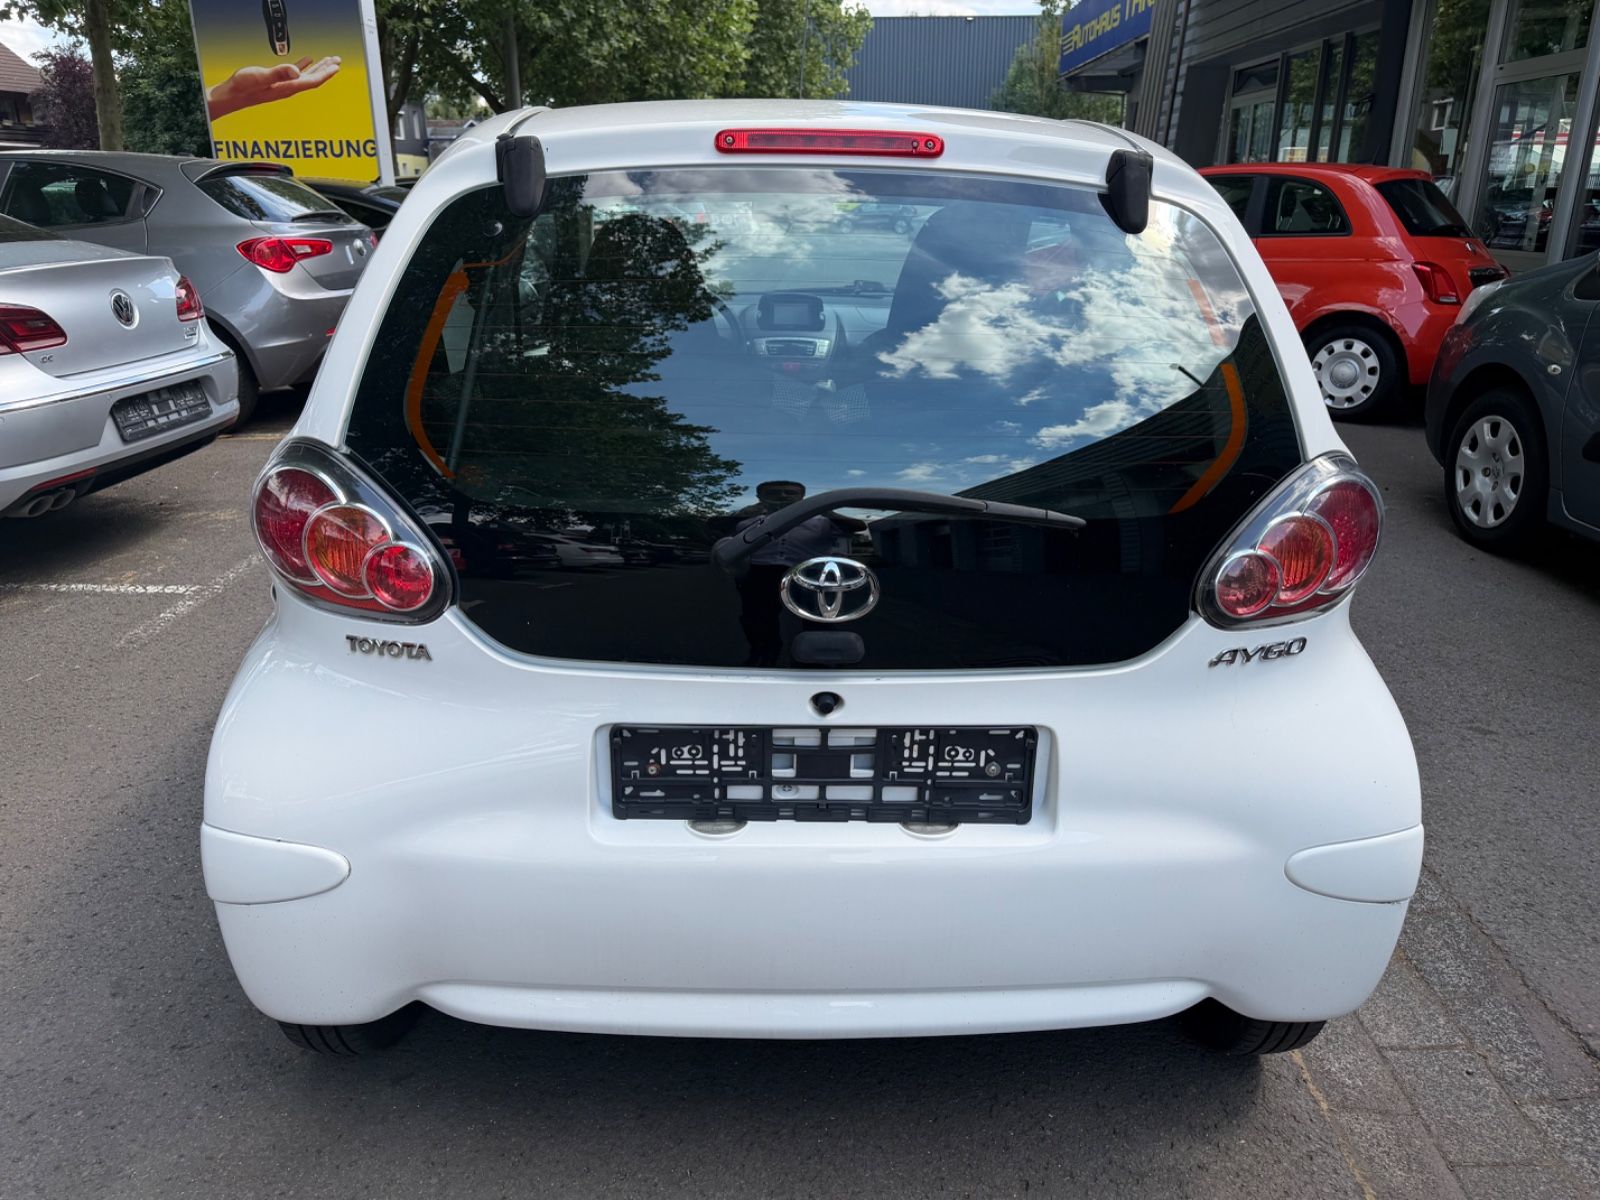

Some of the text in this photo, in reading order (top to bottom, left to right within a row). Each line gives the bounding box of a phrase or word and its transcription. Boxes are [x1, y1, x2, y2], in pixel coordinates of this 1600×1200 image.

[213, 139, 377, 159] FINANZIERUNG
[345, 634, 432, 661] TOYOTA
[1208, 636, 1307, 668] AYGO
